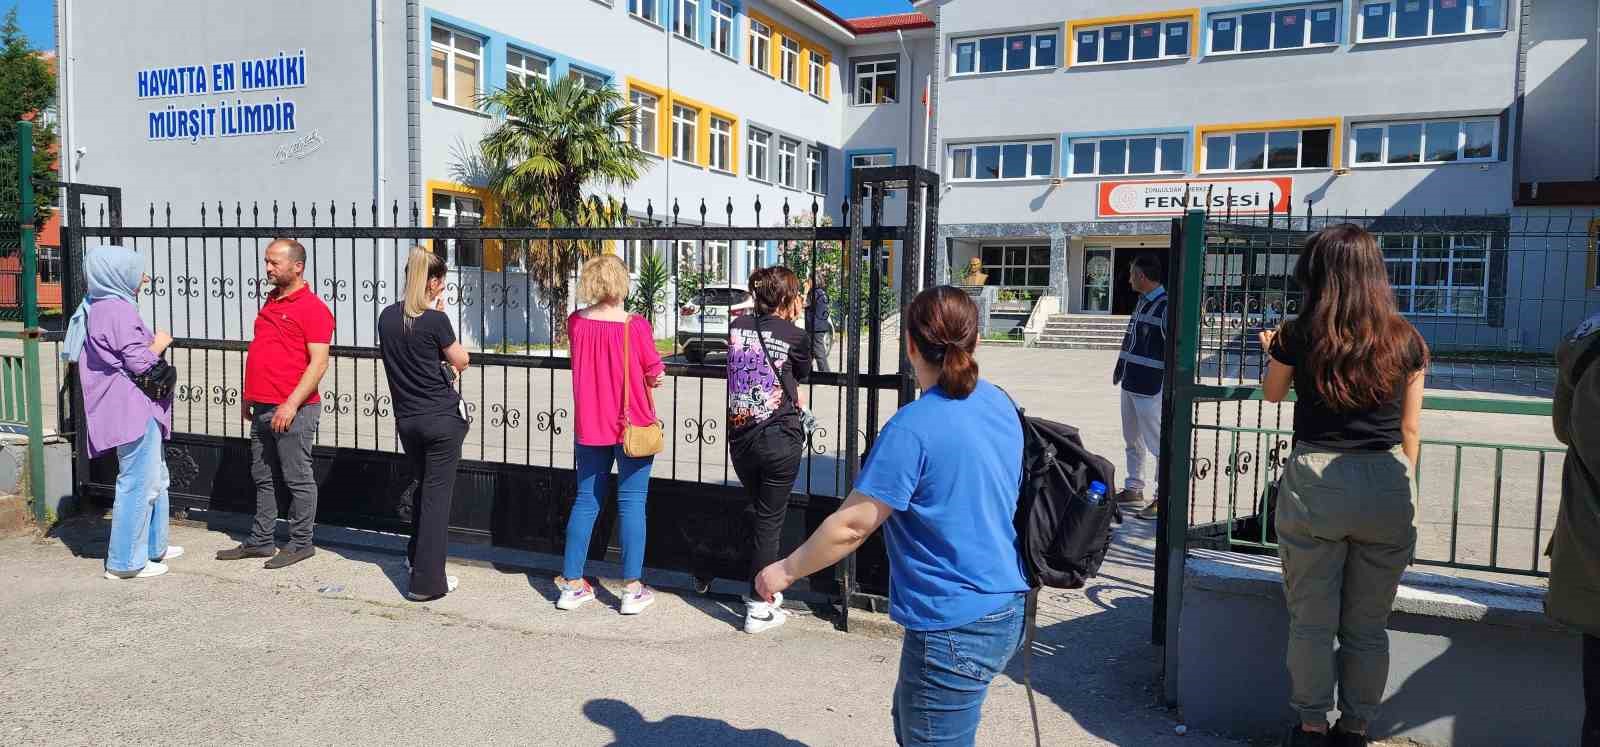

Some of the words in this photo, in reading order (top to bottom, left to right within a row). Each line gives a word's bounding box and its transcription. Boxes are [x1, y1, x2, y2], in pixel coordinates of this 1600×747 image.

[137, 65, 207, 98] HAYATTA
[212, 62, 235, 92] EN
[241, 50, 306, 90] HAKİKİ
[149, 103, 216, 142] MÜRŞİT
[220, 96, 295, 135] İLİMDİR
[1145, 196, 1186, 208] FEN
[1192, 191, 1260, 208] LSESİ
